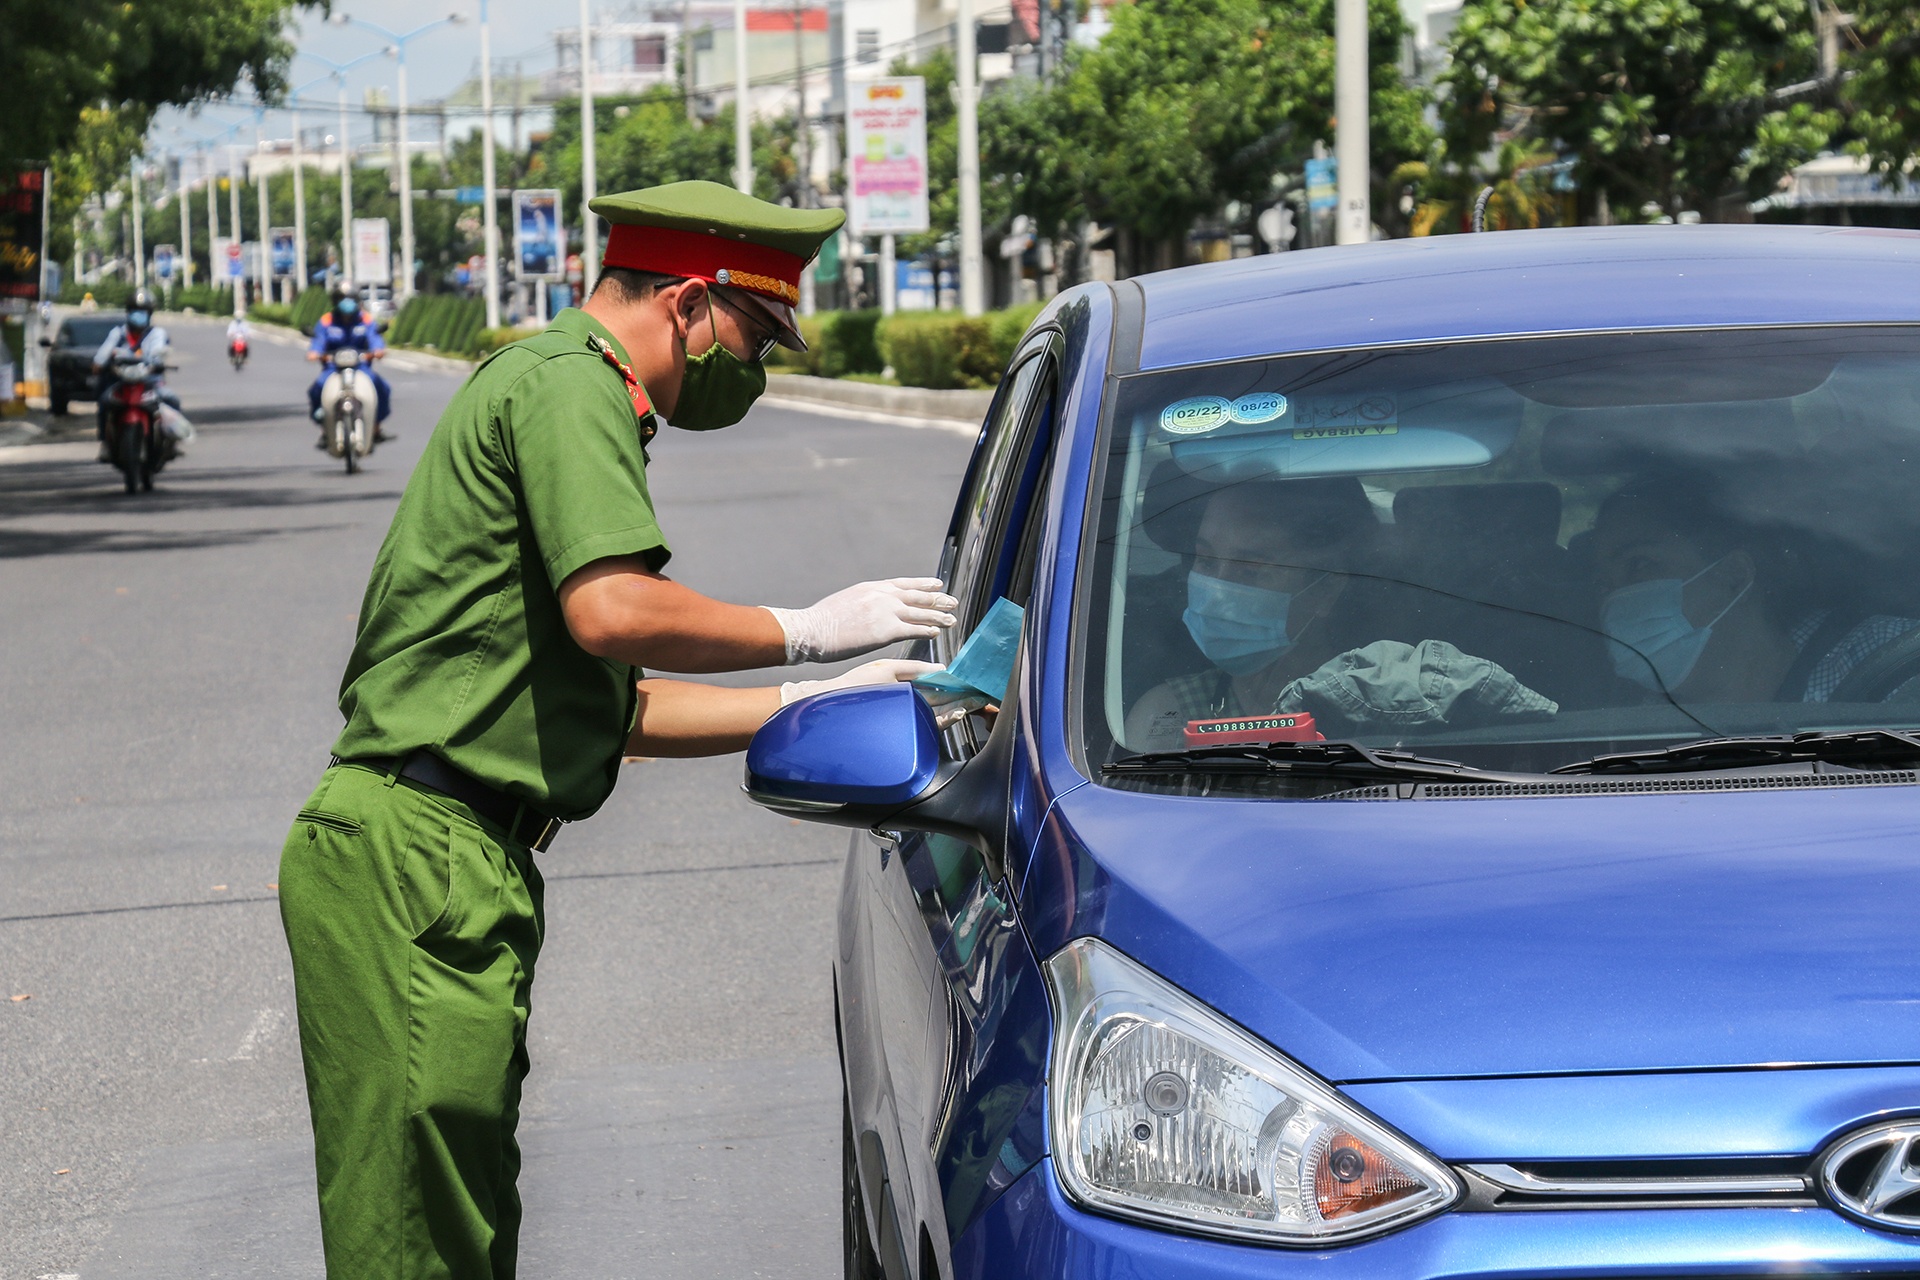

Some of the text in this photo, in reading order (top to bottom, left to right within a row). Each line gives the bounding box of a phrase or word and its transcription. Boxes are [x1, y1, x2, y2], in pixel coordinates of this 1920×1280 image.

[1177, 405, 1221, 419] 02/22
[1241, 400, 1278, 412] 08/20
[1303, 426, 1367, 438] AIRBAG
